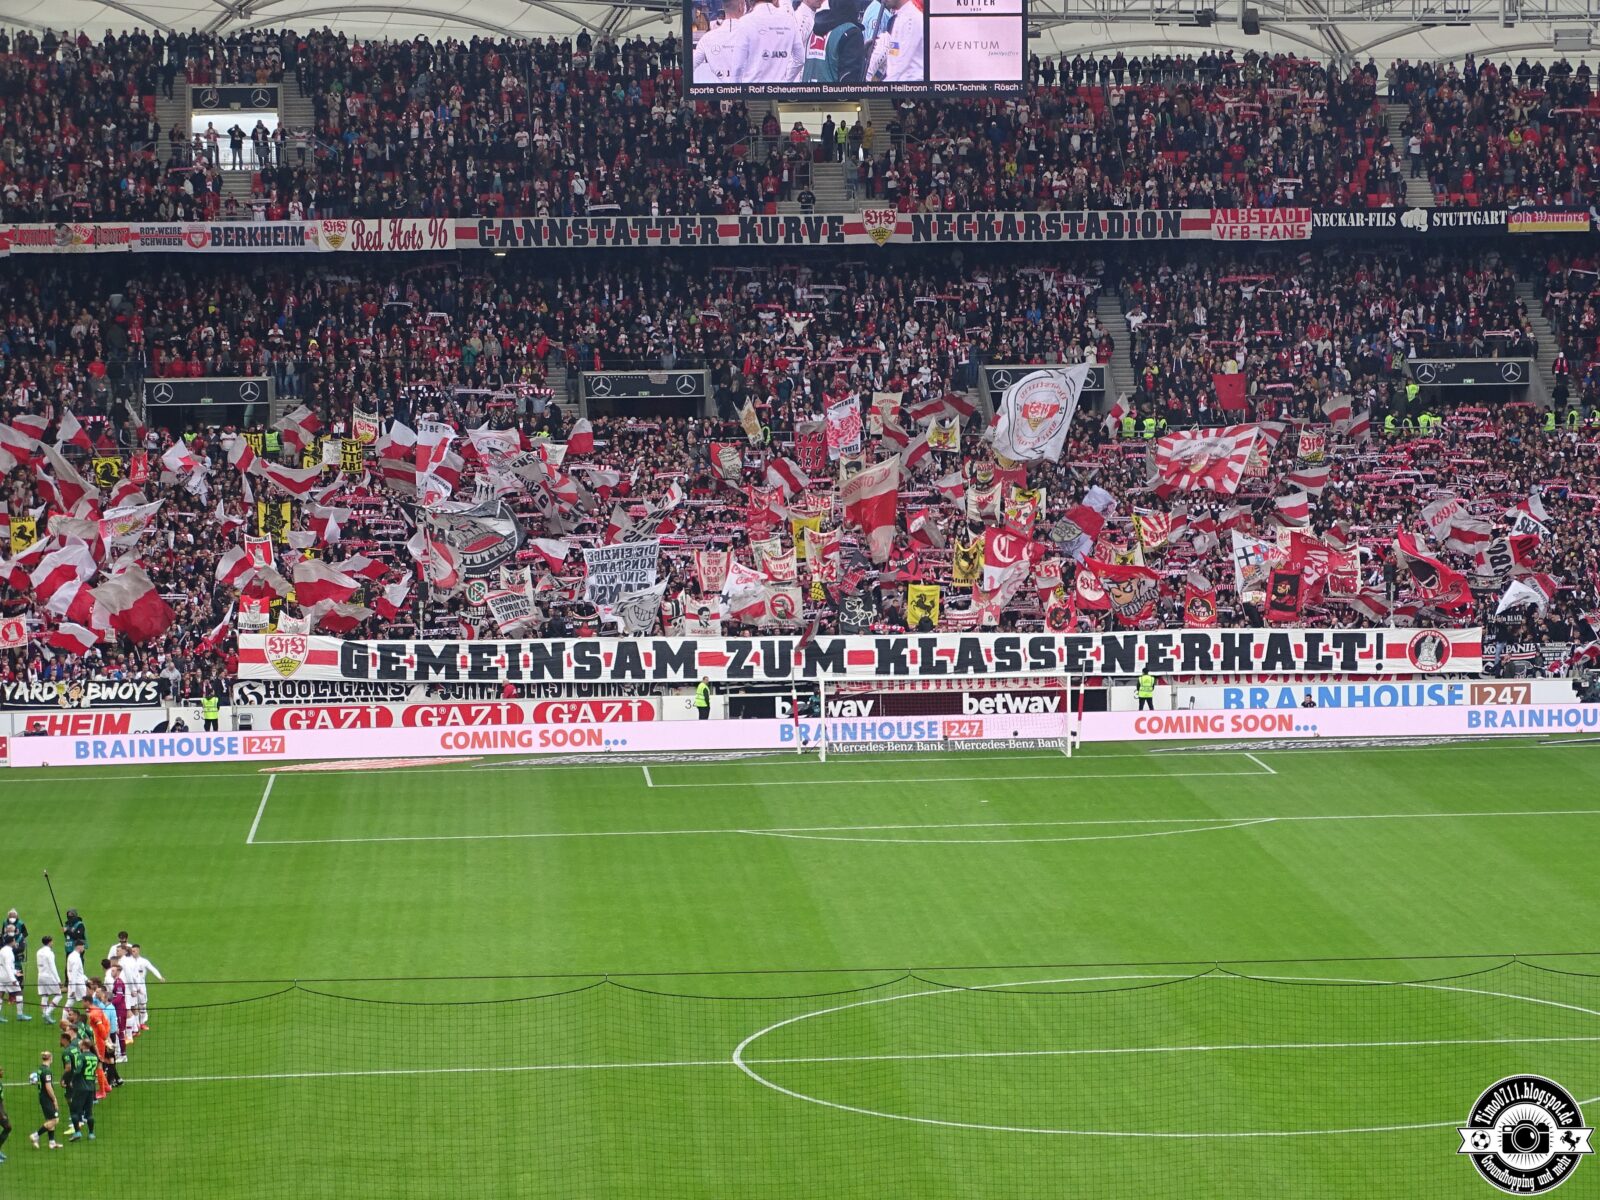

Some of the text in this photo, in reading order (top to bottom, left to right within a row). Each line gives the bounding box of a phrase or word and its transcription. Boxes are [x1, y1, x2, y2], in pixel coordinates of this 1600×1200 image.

[716, 86, 742, 94] GmbH
[749, 85, 765, 93] Rolf
[766, 85, 821, 94] Scheuermann
[822, 84, 889, 93] Bauunternehmen
[890, 84, 928, 92] Heilbronn
[934, 83, 988, 92] ROM-Technik
[994, 82, 1019, 91] Rösch
[1214, 208, 1310, 224] ALBSTADT
[1313, 212, 1396, 228] NECKAR-FILS
[1432, 210, 1508, 227] STUTTGART
[210, 226, 305, 246] BERKHEIM
[351, 216, 448, 251] Red Hots 96
[478, 215, 845, 248] CANNSTATTER KURVE
[911, 211, 1182, 242] NECKARSTADION
[1216, 225, 1306, 240] VFB-FANS
[140, 237, 183, 247] SCHWABEN
[340, 631, 1384, 680] GEMEINSAM ZUM KLASSENERHALT!
[1483, 642, 1537, 655] KOPANIE
[2, 680, 159, 703] YARD BWOYS
[263, 680, 404, 699] HOOLIGANS
[962, 692, 1061, 714] betway
[779, 720, 938, 742] BRAINHOUSE
[1134, 715, 1225, 735] COMING
[75, 736, 239, 760] BRAINHOUSE
[440, 730, 532, 750] COMING
[833, 740, 944, 753] Mercedes-Benz Bank
[954, 738, 1066, 751] Mercedes-Benz Bank
